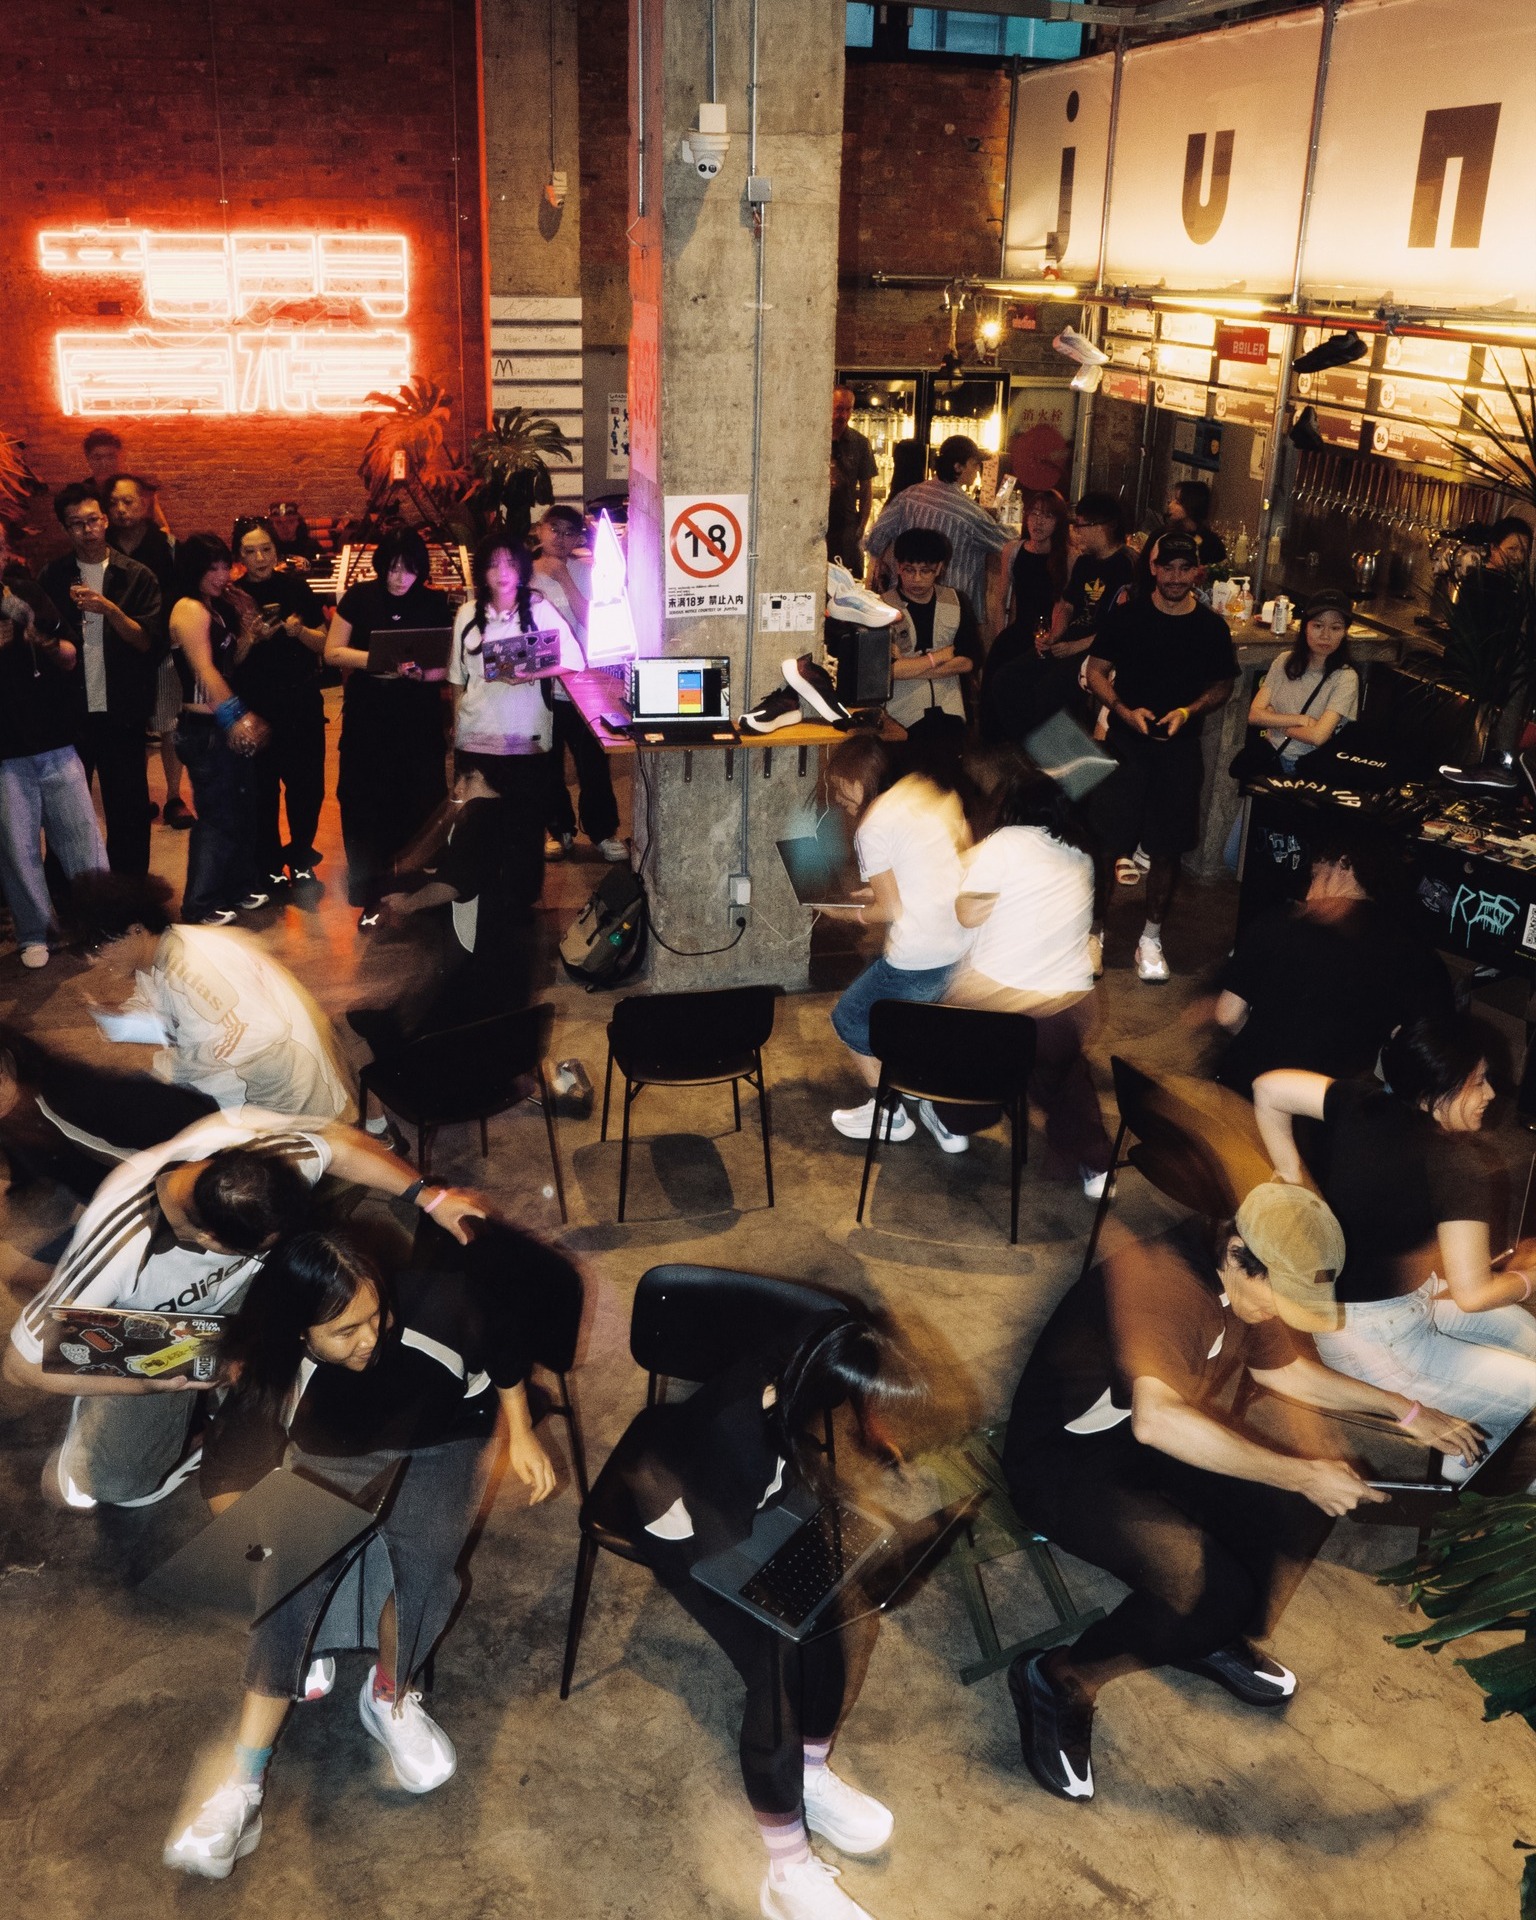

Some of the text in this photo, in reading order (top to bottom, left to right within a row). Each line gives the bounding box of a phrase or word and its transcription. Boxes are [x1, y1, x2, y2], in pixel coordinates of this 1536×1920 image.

[1376, 433, 1385, 444] B6
[684, 524, 727, 558] 18
[709, 594, 744, 605] 禁止入内
[153, 1255, 248, 1312] adida
[198, 1353, 211, 1378] SHOE
